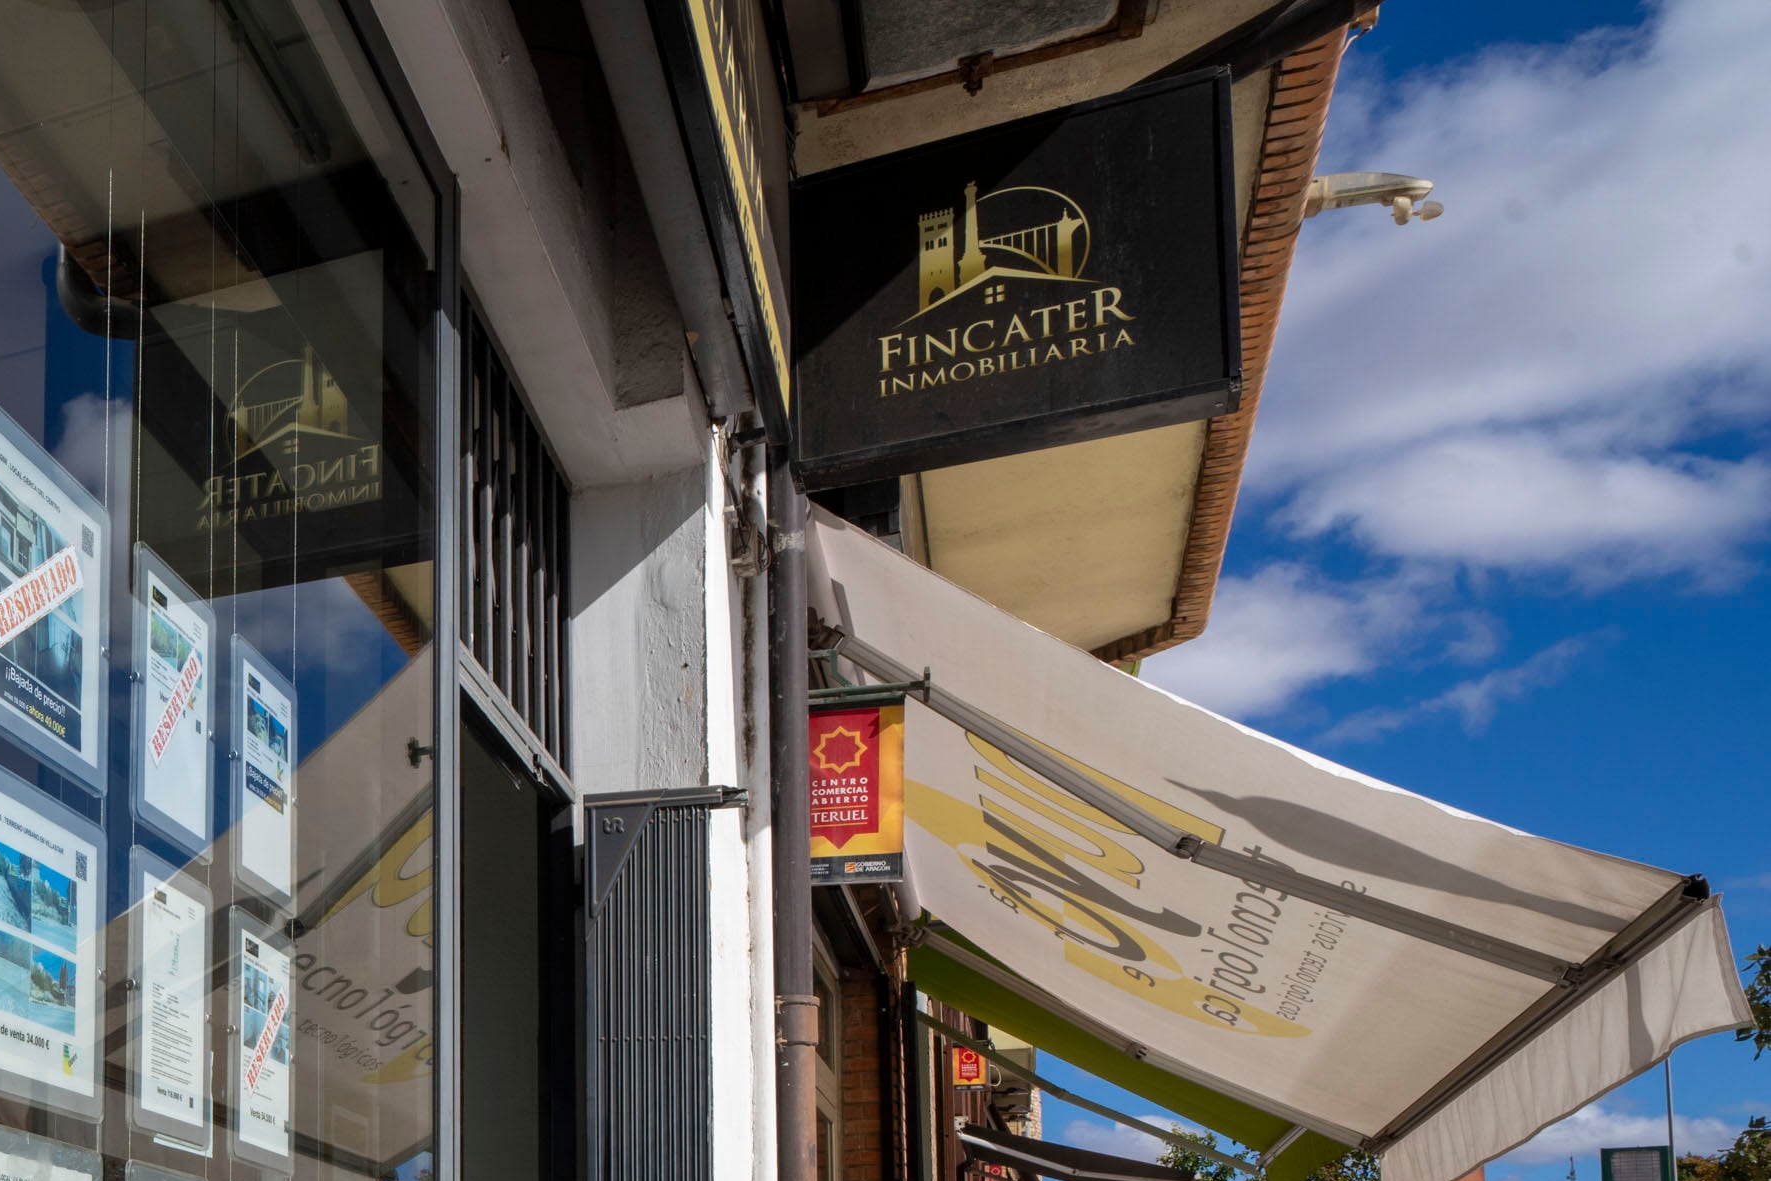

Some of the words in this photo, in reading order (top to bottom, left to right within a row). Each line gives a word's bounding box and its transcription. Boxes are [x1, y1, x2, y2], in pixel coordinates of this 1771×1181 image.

[879, 287, 1136, 372] FINCATER
[880, 329, 1136, 398] INMOBILIARIA
[29, 704, 44, 723] ahora
[152, 656, 197, 757] RESERVADO
[812, 777, 868, 787] CENTRO
[812, 787, 868, 796] COMERCIAL
[812, 796, 868, 805] ABIERTO
[812, 810, 868, 823] TERUEL
[0, 1024, 8, 1036] de
[10, 1029, 25, 1041] venta
[26, 1033, 44, 1048] 34.000
[46, 1040, 50, 1050] €
[247, 993, 285, 1089] RESERVADO
